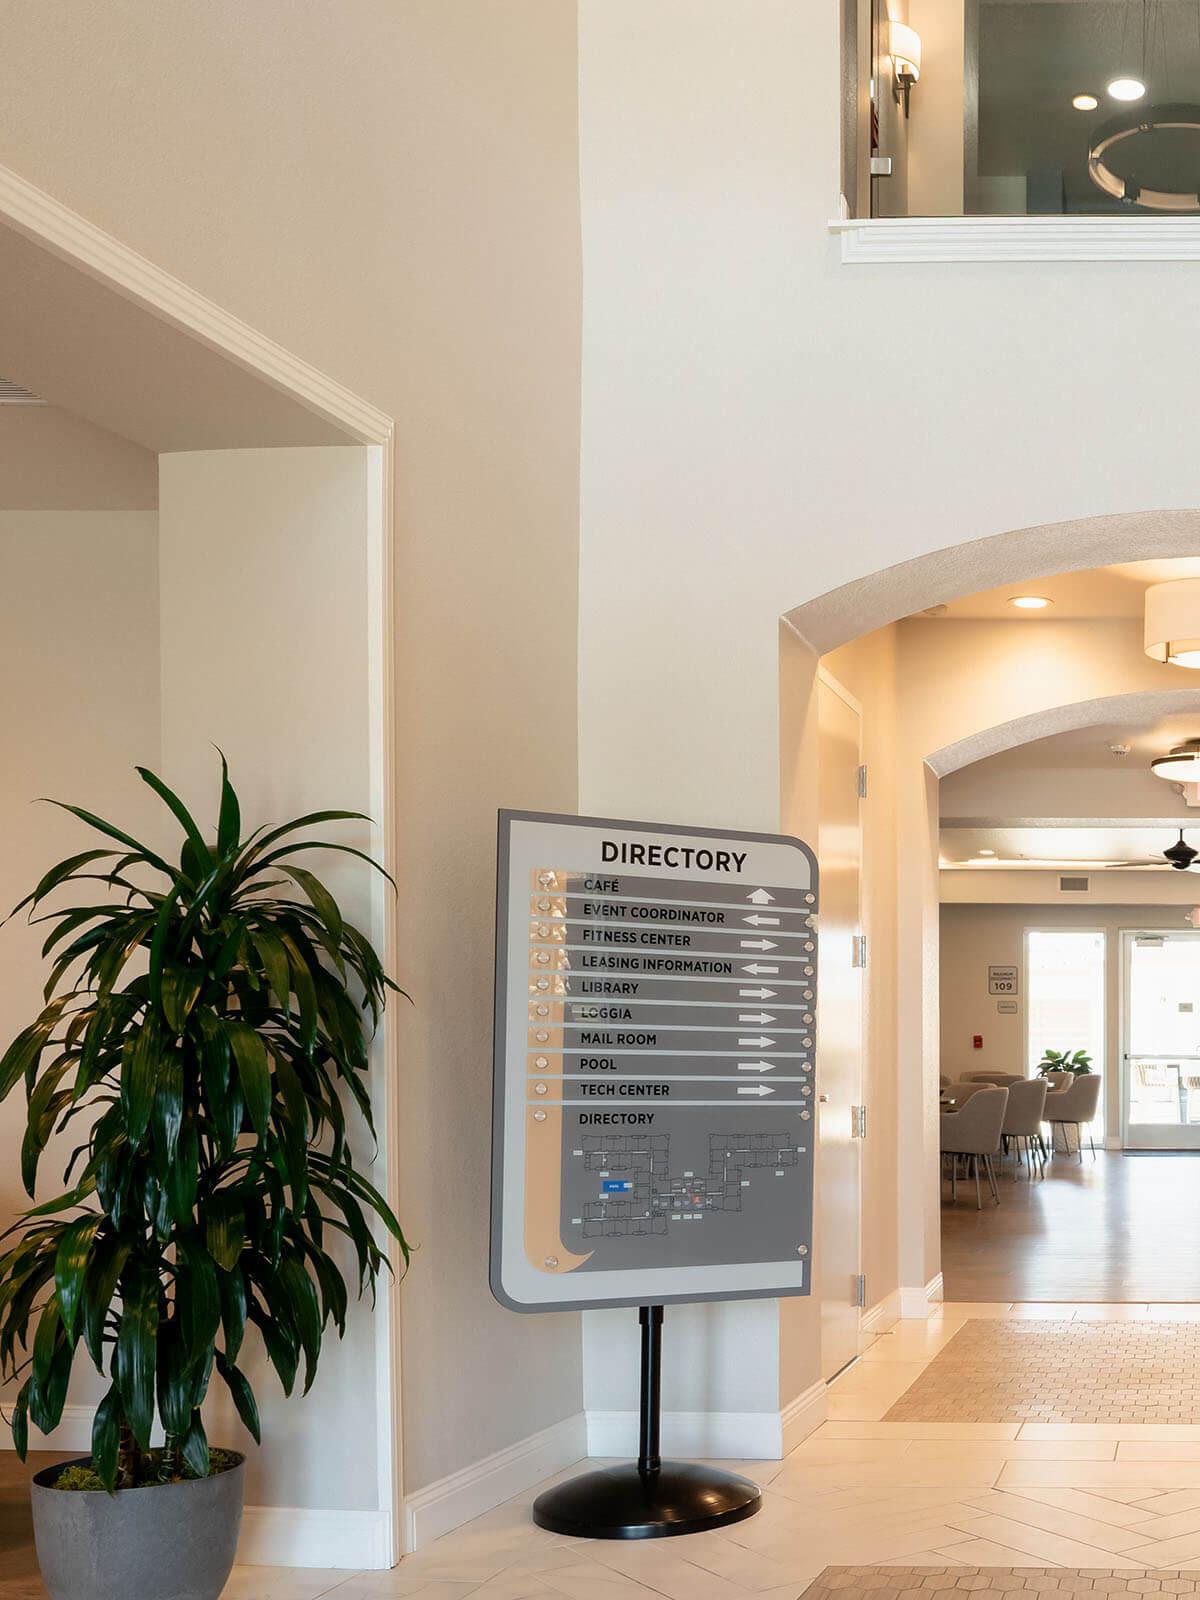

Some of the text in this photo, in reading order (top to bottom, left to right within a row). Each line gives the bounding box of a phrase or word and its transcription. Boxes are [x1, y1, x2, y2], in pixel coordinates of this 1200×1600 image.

[602, 841, 747, 873] DIRECTORY
[584, 879, 619, 892] CAFÉ
[583, 904, 725, 923] EVENT COORDINATOR
[583, 930, 691, 946] FITNESS CENTER
[582, 956, 732, 973] LEASING INFORMATION
[582, 982, 639, 994] LIBRARY
[994, 982, 1012, 990] 109
[581, 1007, 632, 1020] LOGGIA
[581, 1033, 657, 1045] MAIL ROOM
[580, 1058, 617, 1070] POOL
[581, 1084, 670, 1096] TECH CENTER
[579, 1113, 655, 1125] DIRECTORY
